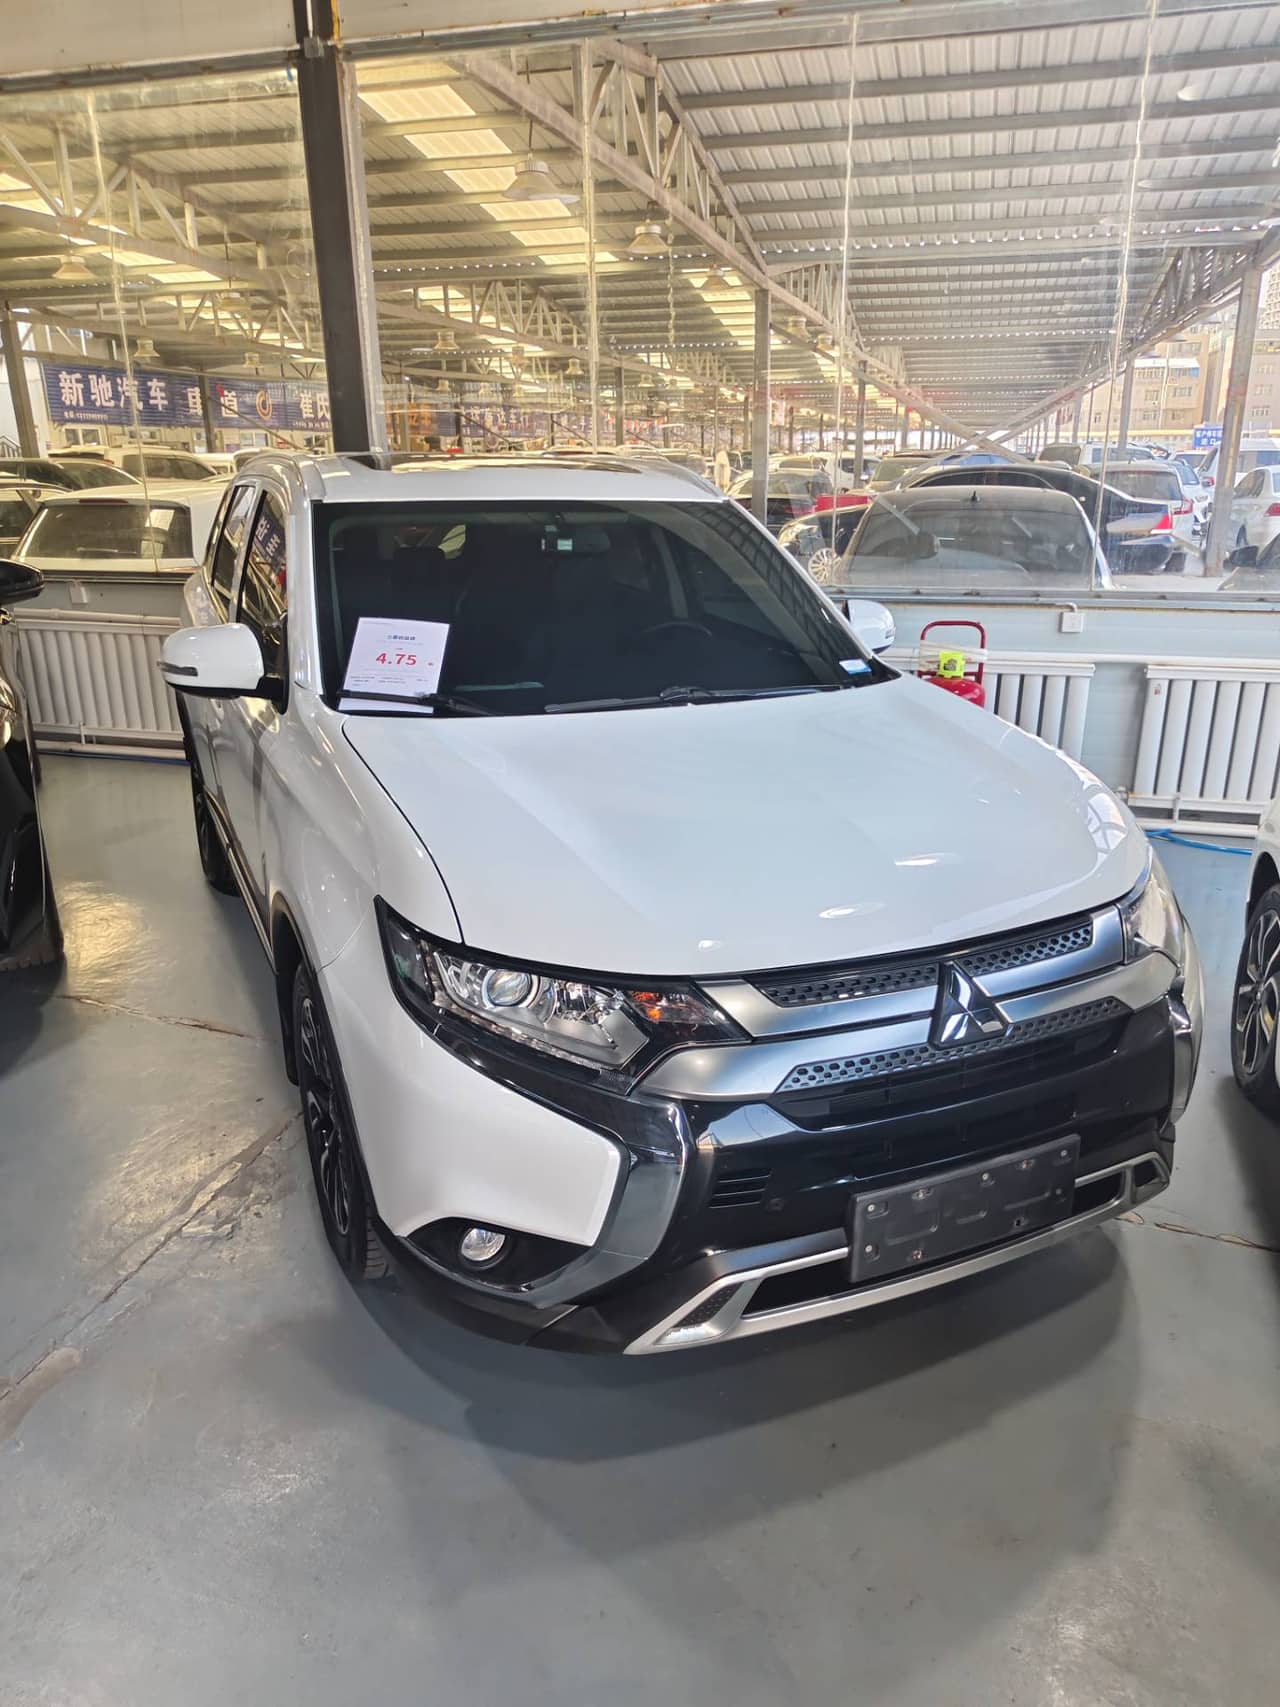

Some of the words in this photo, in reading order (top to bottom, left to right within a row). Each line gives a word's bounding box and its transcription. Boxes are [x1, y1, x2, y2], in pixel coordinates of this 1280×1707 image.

[58, 371, 169, 411] 新驰汽车
[375, 652, 417, 666] 4.75
